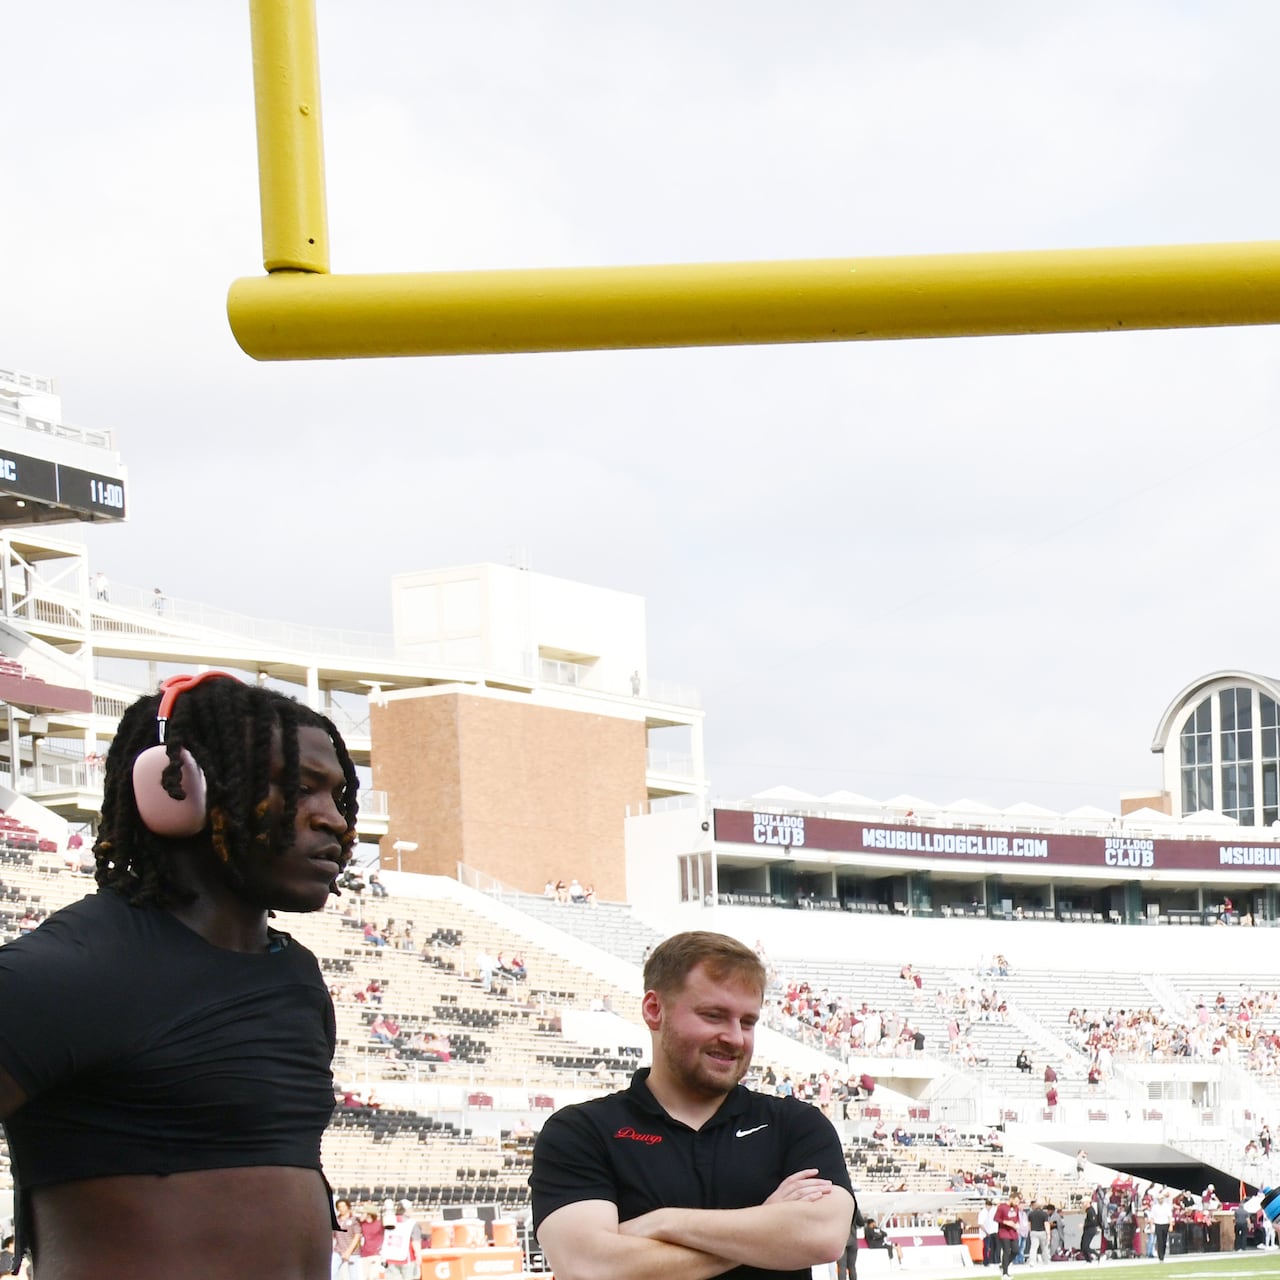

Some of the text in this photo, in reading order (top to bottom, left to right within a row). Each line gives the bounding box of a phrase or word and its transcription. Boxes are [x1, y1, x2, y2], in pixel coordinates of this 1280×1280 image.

[90, 479, 123, 509] 11:00
[753, 813, 805, 828] BULLDOG
[753, 827, 805, 847] CLUB
[862, 828, 1048, 858] MSUBULLDOGCLUB.COM
[1104, 838, 1154, 851] BULLDOG
[1104, 848, 1154, 868] CLUB
[615, 1127, 663, 1145] Dawgs
[435, 1261, 451, 1280] G
